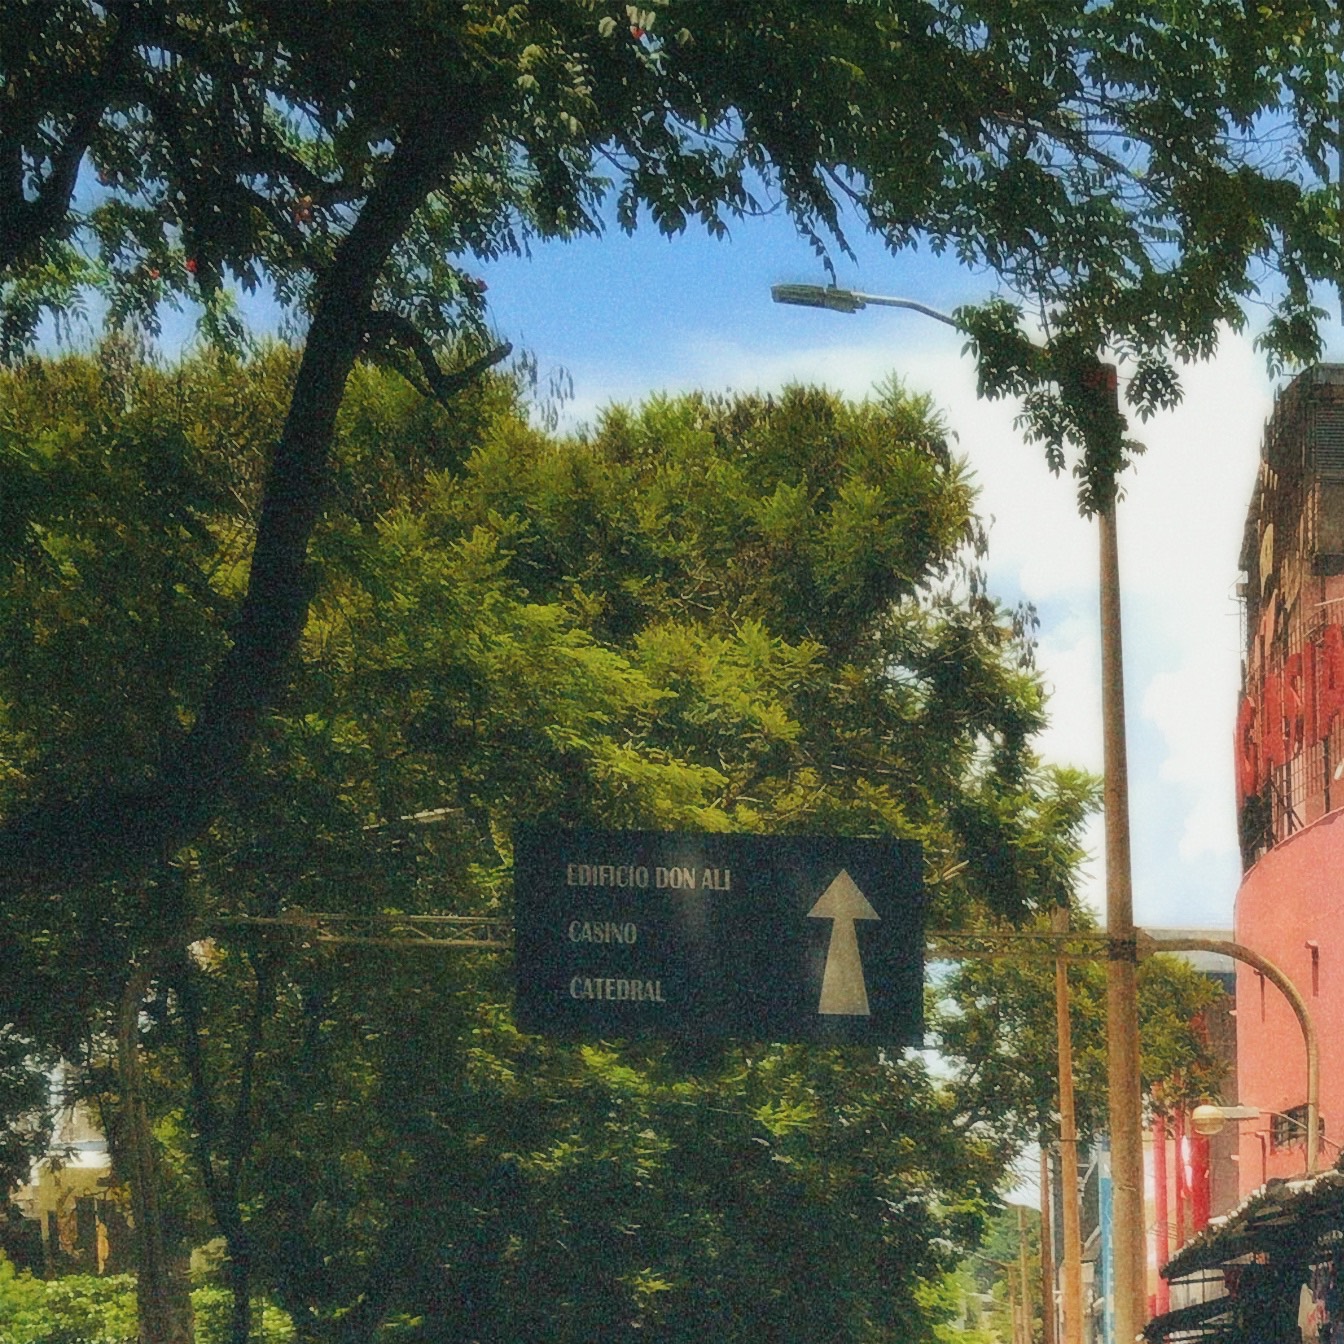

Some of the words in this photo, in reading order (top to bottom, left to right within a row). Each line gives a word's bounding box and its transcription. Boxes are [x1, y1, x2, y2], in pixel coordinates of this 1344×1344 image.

[567, 863, 649, 888] EDIFICIO
[655, 867, 696, 889] DON
[701, 867, 731, 891] ALI
[568, 920, 637, 945] CASINO
[570, 976, 666, 1002] CATEDRAL
